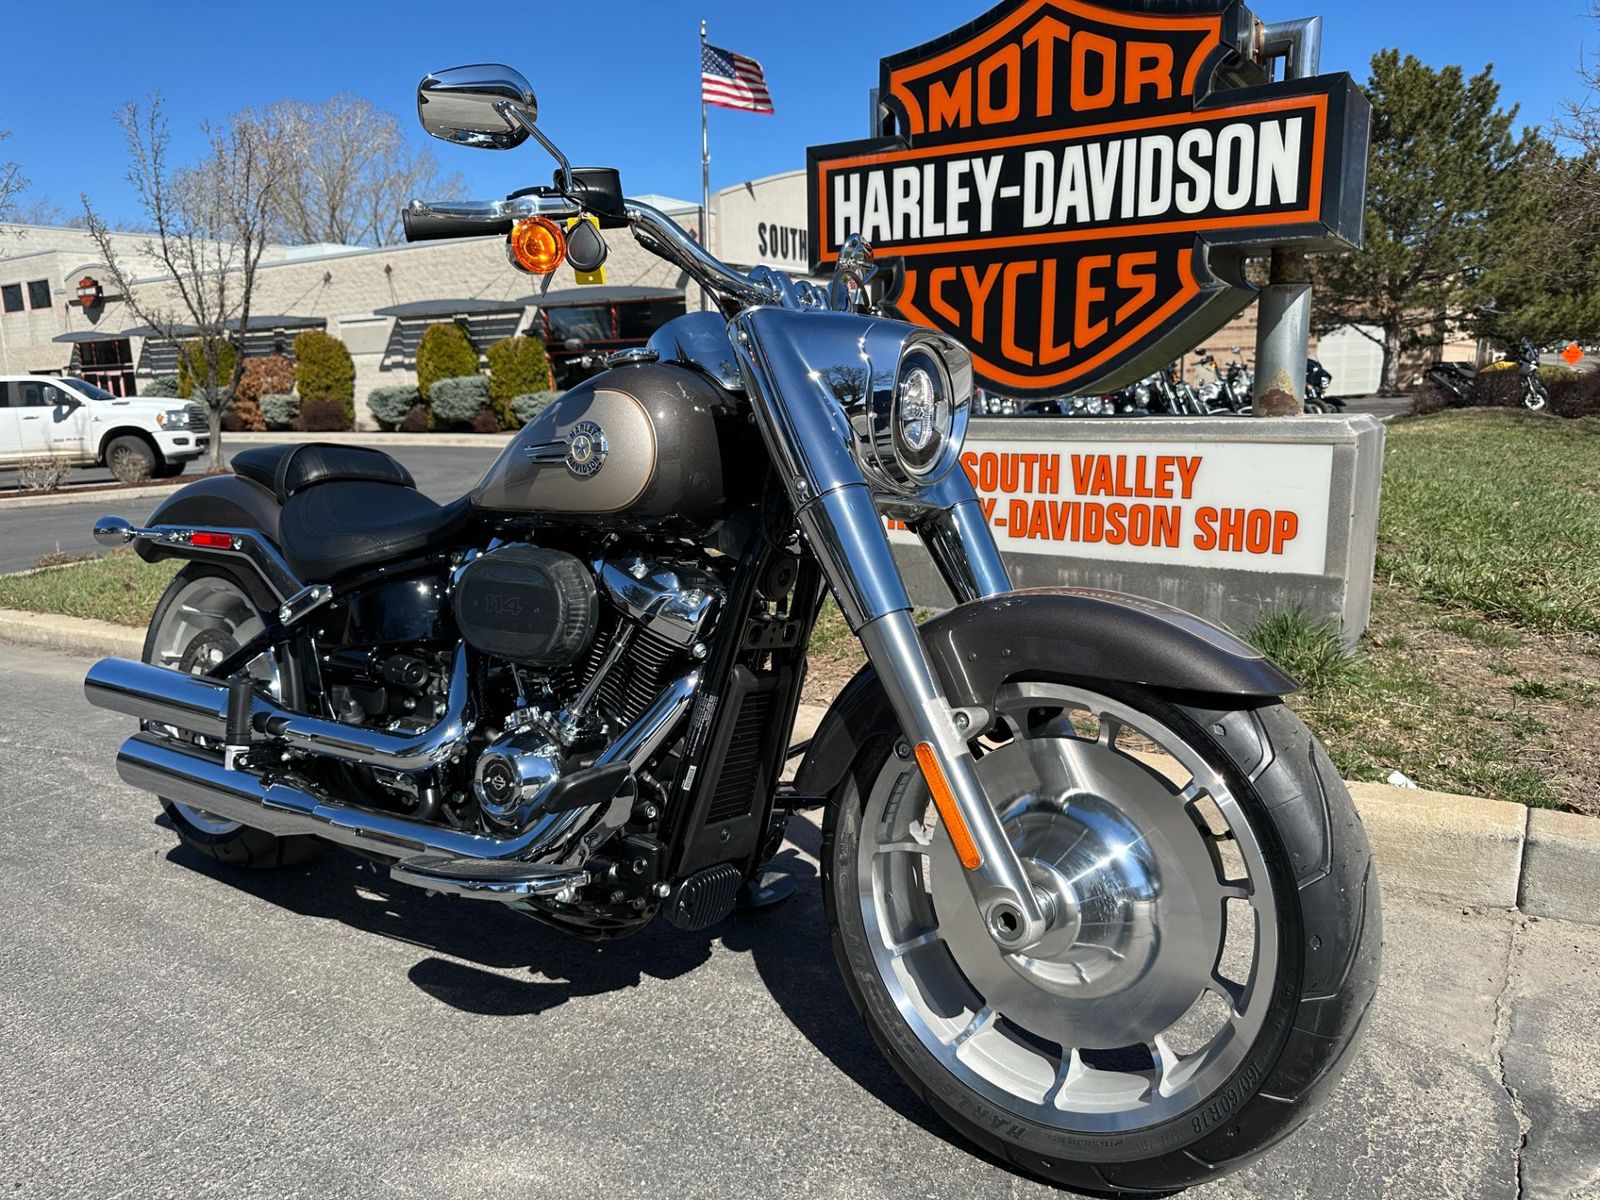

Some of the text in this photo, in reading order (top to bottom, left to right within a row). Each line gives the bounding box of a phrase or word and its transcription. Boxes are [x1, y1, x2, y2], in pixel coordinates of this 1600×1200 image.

[928, 15, 1174, 133] MOTOR
[833, 116, 1303, 246] HARLEY-DAVIDSON
[929, 251, 1157, 367] CYCLES
[961, 451, 1203, 500] SOUTH VALLEY
[1193, 505, 1299, 556] SHOP
[484, 593, 522, 616] 114
